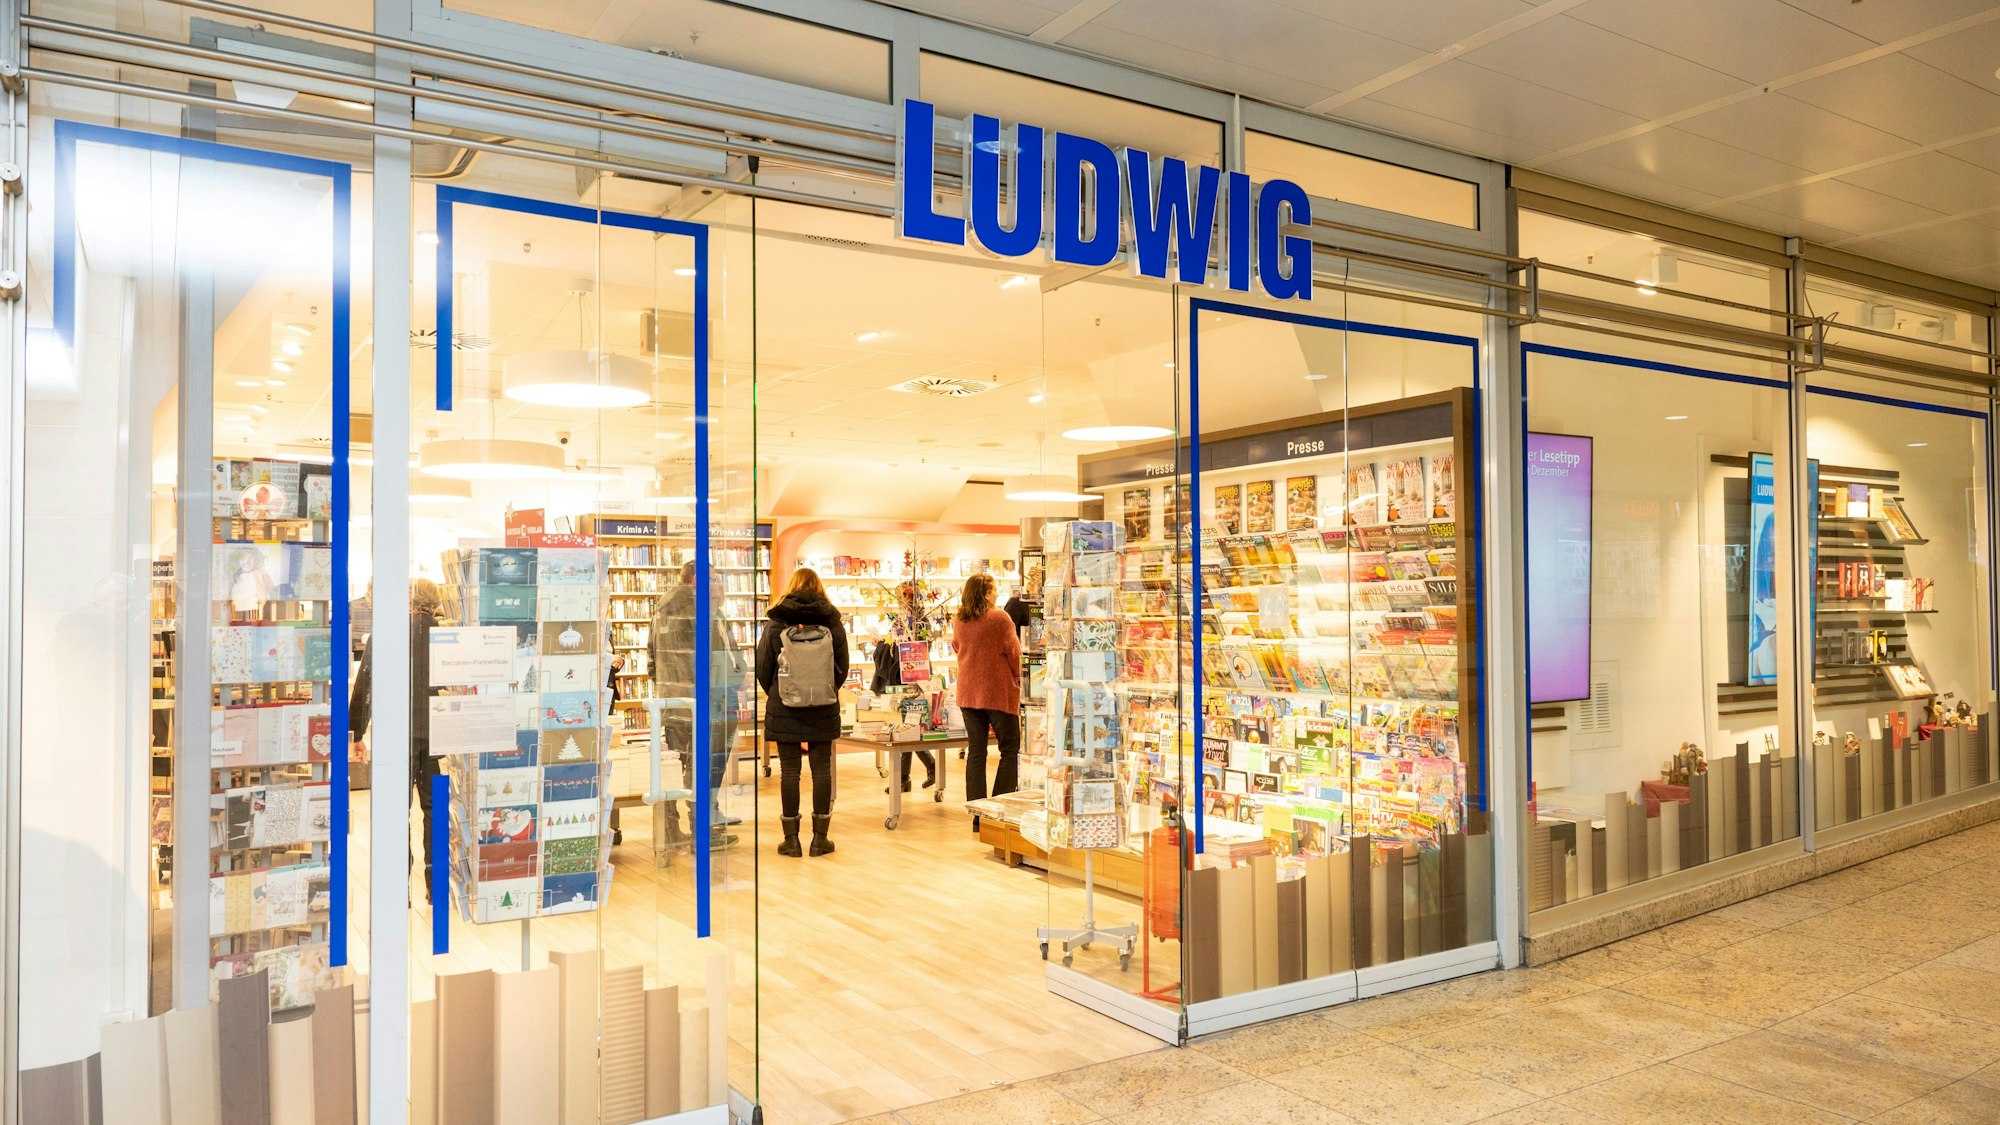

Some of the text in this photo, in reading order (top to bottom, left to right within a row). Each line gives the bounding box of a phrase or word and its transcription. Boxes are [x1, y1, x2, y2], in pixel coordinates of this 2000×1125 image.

[902, 98, 1314, 301] LUDWIG
[1287, 440, 1325, 456] Presse
[1540, 449, 1580, 468] Lesetipp
[1146, 463, 1175, 476] Presse
[1531, 464, 1570, 477] Dezember
[617, 525, 642, 534] Krimis
[643, 526, 649, 534] A
[711, 528, 736, 537] Krimis
[1389, 584, 1423, 593] H.O.M.E.
[1307, 721, 1334, 733] kicker
